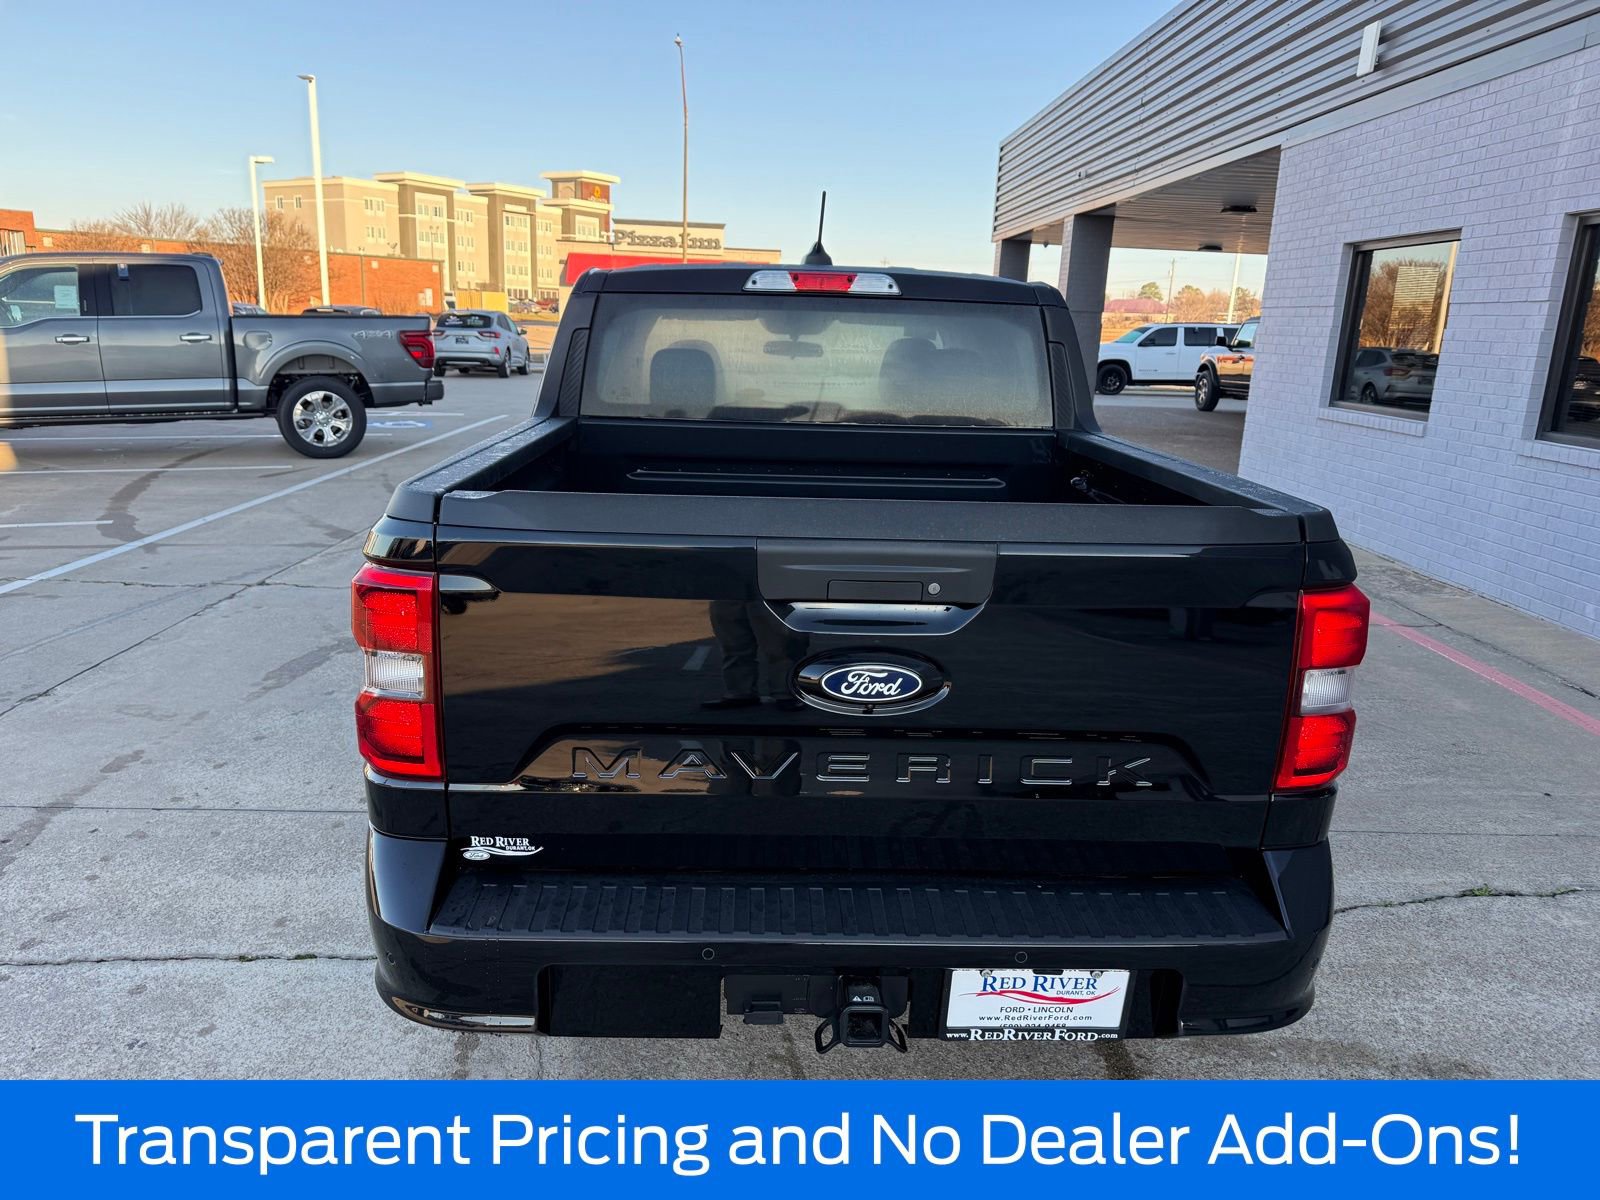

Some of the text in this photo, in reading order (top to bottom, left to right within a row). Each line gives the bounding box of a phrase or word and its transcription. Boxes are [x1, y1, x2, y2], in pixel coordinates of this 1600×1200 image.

[613, 229, 677, 248] Pizza
[840, 670, 903, 696] Ford
[571, 746, 1153, 788] MAVERICK
[470, 835, 530, 847] RED RIVER
[981, 975, 1098, 993] RED RIVER
